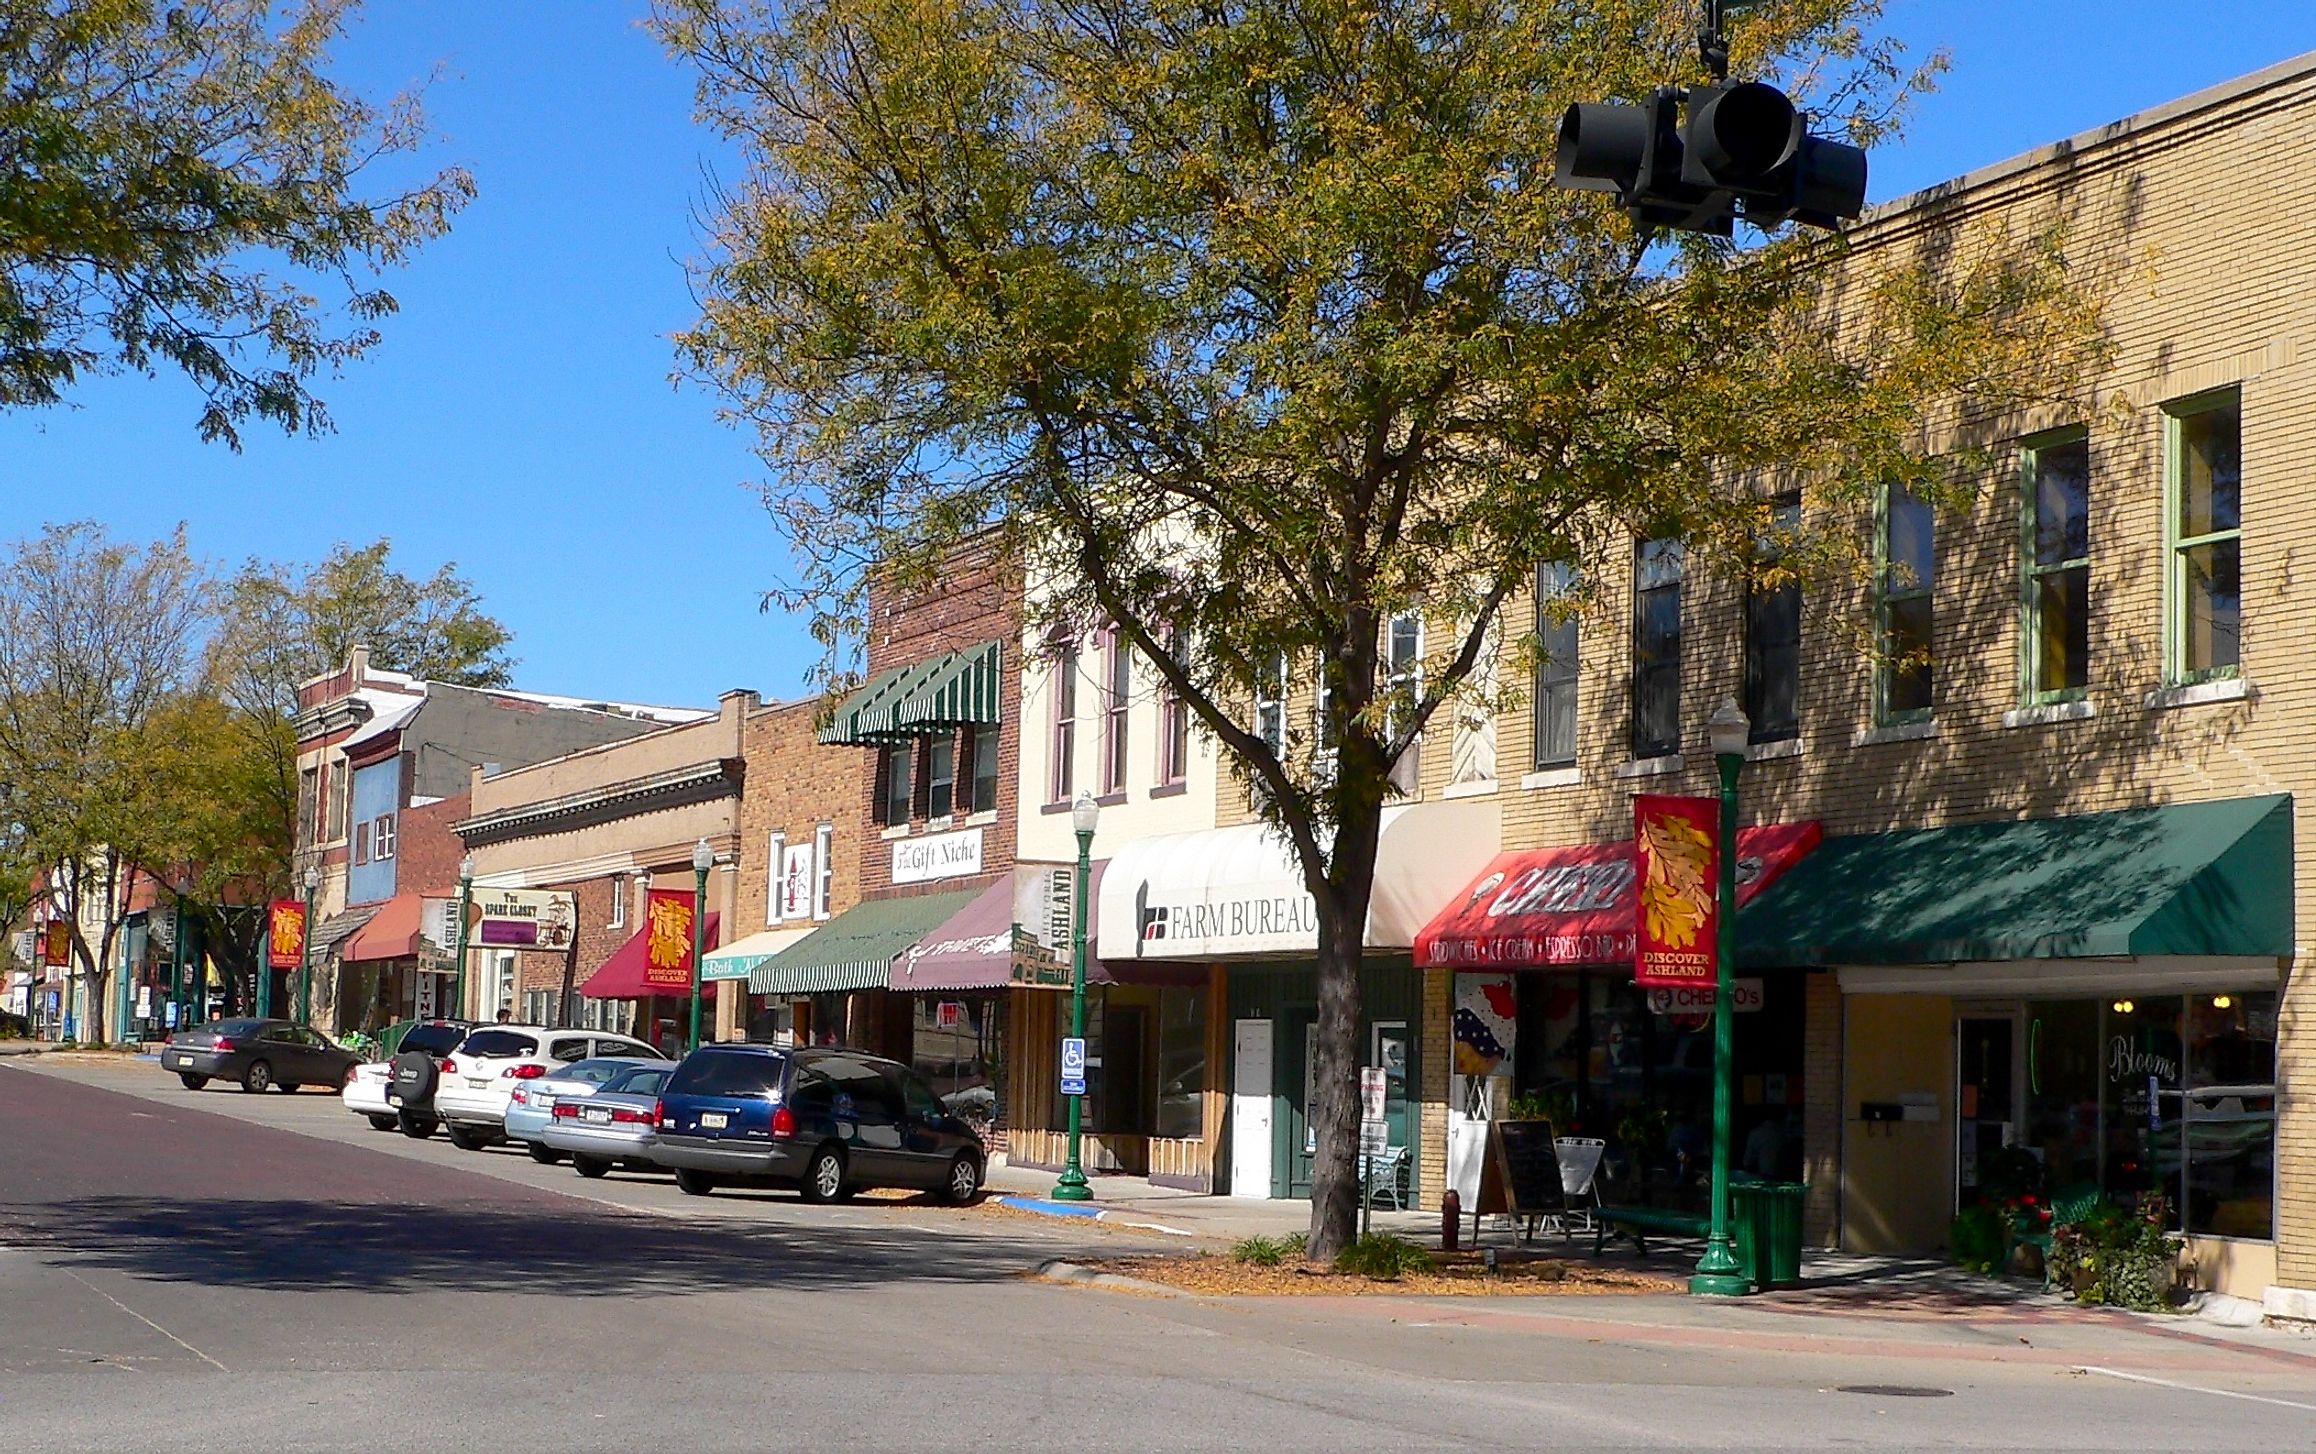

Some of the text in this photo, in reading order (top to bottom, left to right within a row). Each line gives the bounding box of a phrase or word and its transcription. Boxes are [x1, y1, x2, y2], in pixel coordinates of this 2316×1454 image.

[912, 842, 935, 877] Gift
[941, 836, 975, 865] Niche
[445, 901, 458, 950] ASHLAND
[1051, 870, 1072, 951] ASHLAND
[1171, 896, 1317, 939] FARM BUREAU
[1488, 939, 1503, 961] ICE
[1545, 936, 1593, 960] ESPRESSO
[1643, 952, 1709, 965] DISCOVER
[1645, 964, 1706, 976] ASHLAND
[400, 1067, 419, 1079] Jeep
[2107, 1034, 2176, 1082] Blooms
